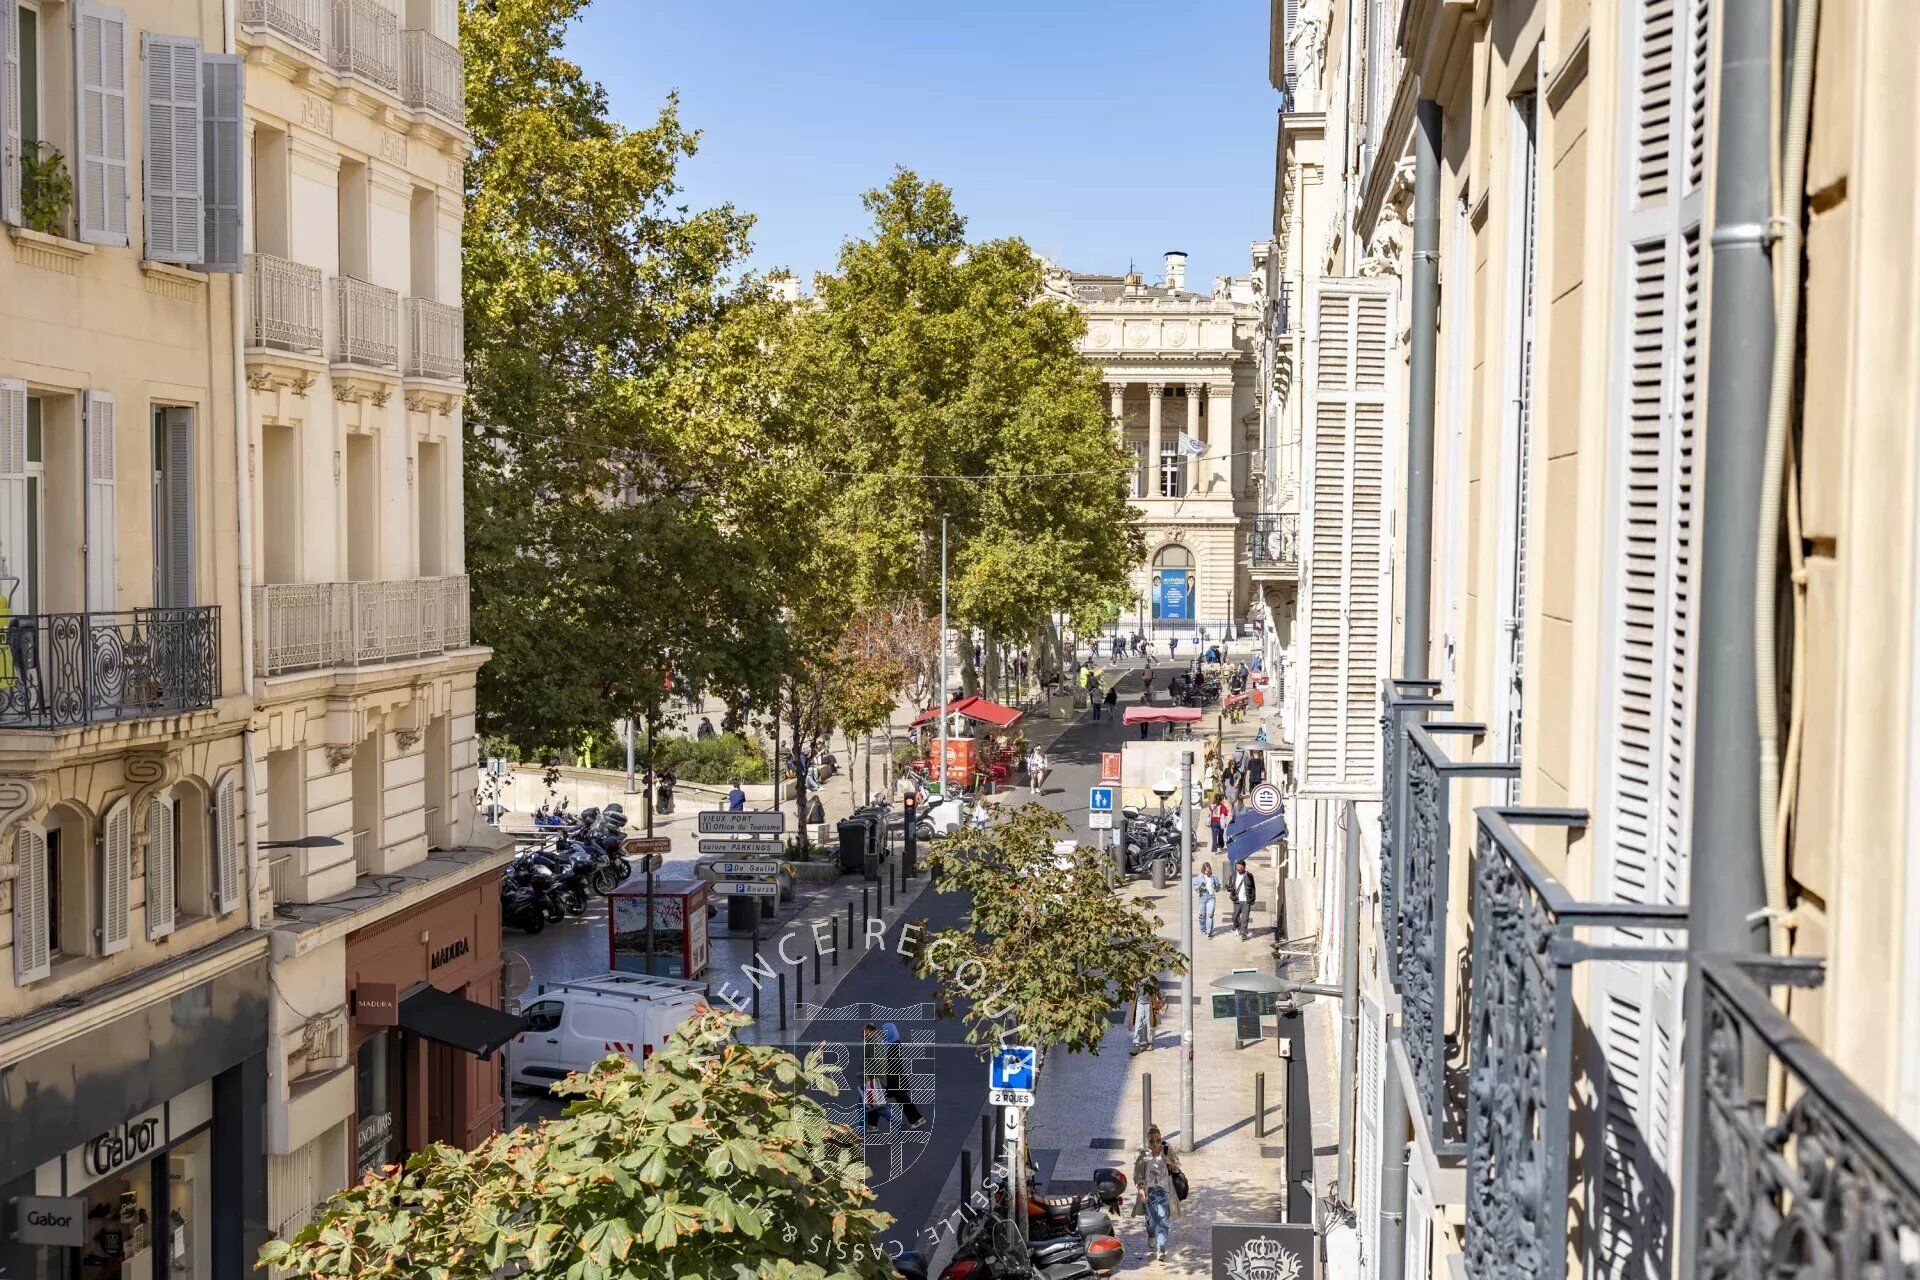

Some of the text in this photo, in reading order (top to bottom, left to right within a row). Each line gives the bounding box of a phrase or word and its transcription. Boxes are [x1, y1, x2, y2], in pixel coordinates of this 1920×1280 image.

[713, 823, 735, 831] Office
[738, 823, 746, 831] du
[750, 823, 780, 831] Tourisme
[732, 843, 771, 851] PARKINGS
[750, 864, 775, 872] Gaulle
[747, 885, 774, 893] Bourse
[431, 937, 469, 970] MADURA
[995, 1094, 1029, 1103] 2 ROUES
[93, 1117, 158, 1176] Gabor
[28, 1211, 72, 1227] Gabor
